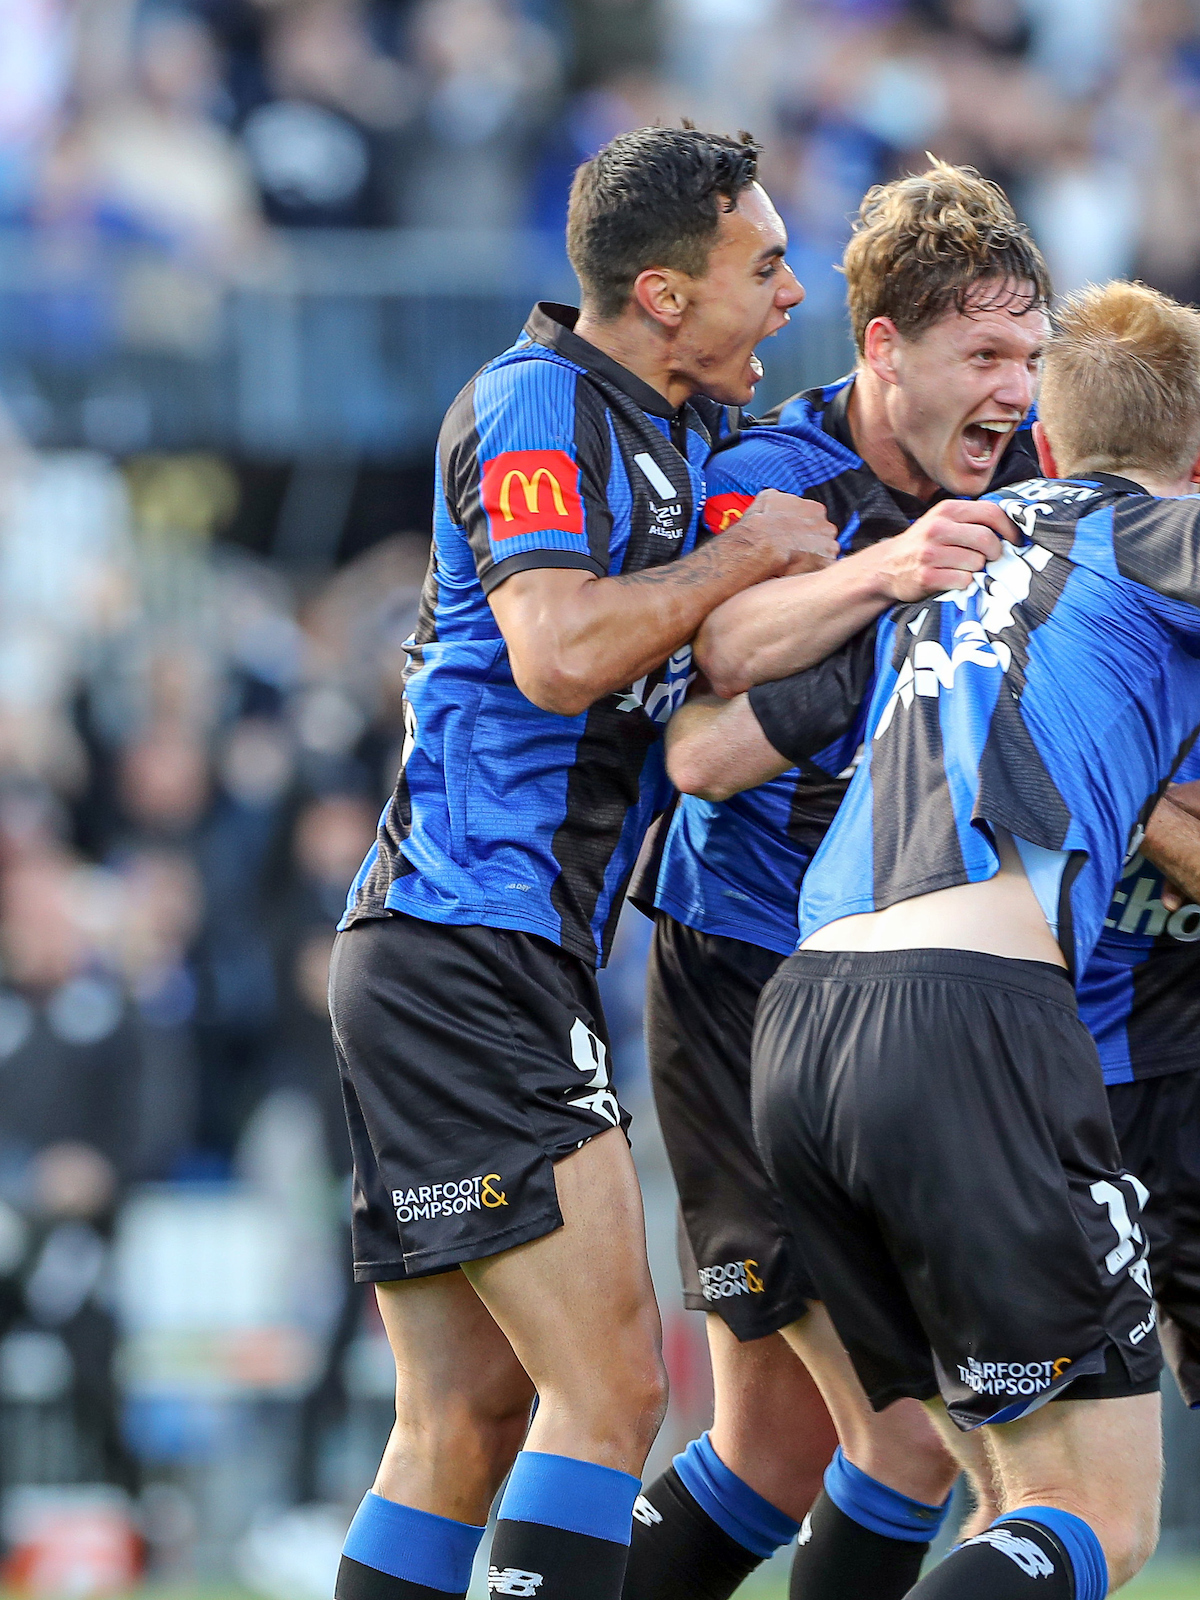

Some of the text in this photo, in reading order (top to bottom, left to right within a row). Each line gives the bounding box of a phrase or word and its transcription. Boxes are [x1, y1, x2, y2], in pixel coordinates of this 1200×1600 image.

[391, 1173, 509, 1208] BARFOOT &
[394, 1193, 481, 1222] OMPSON
